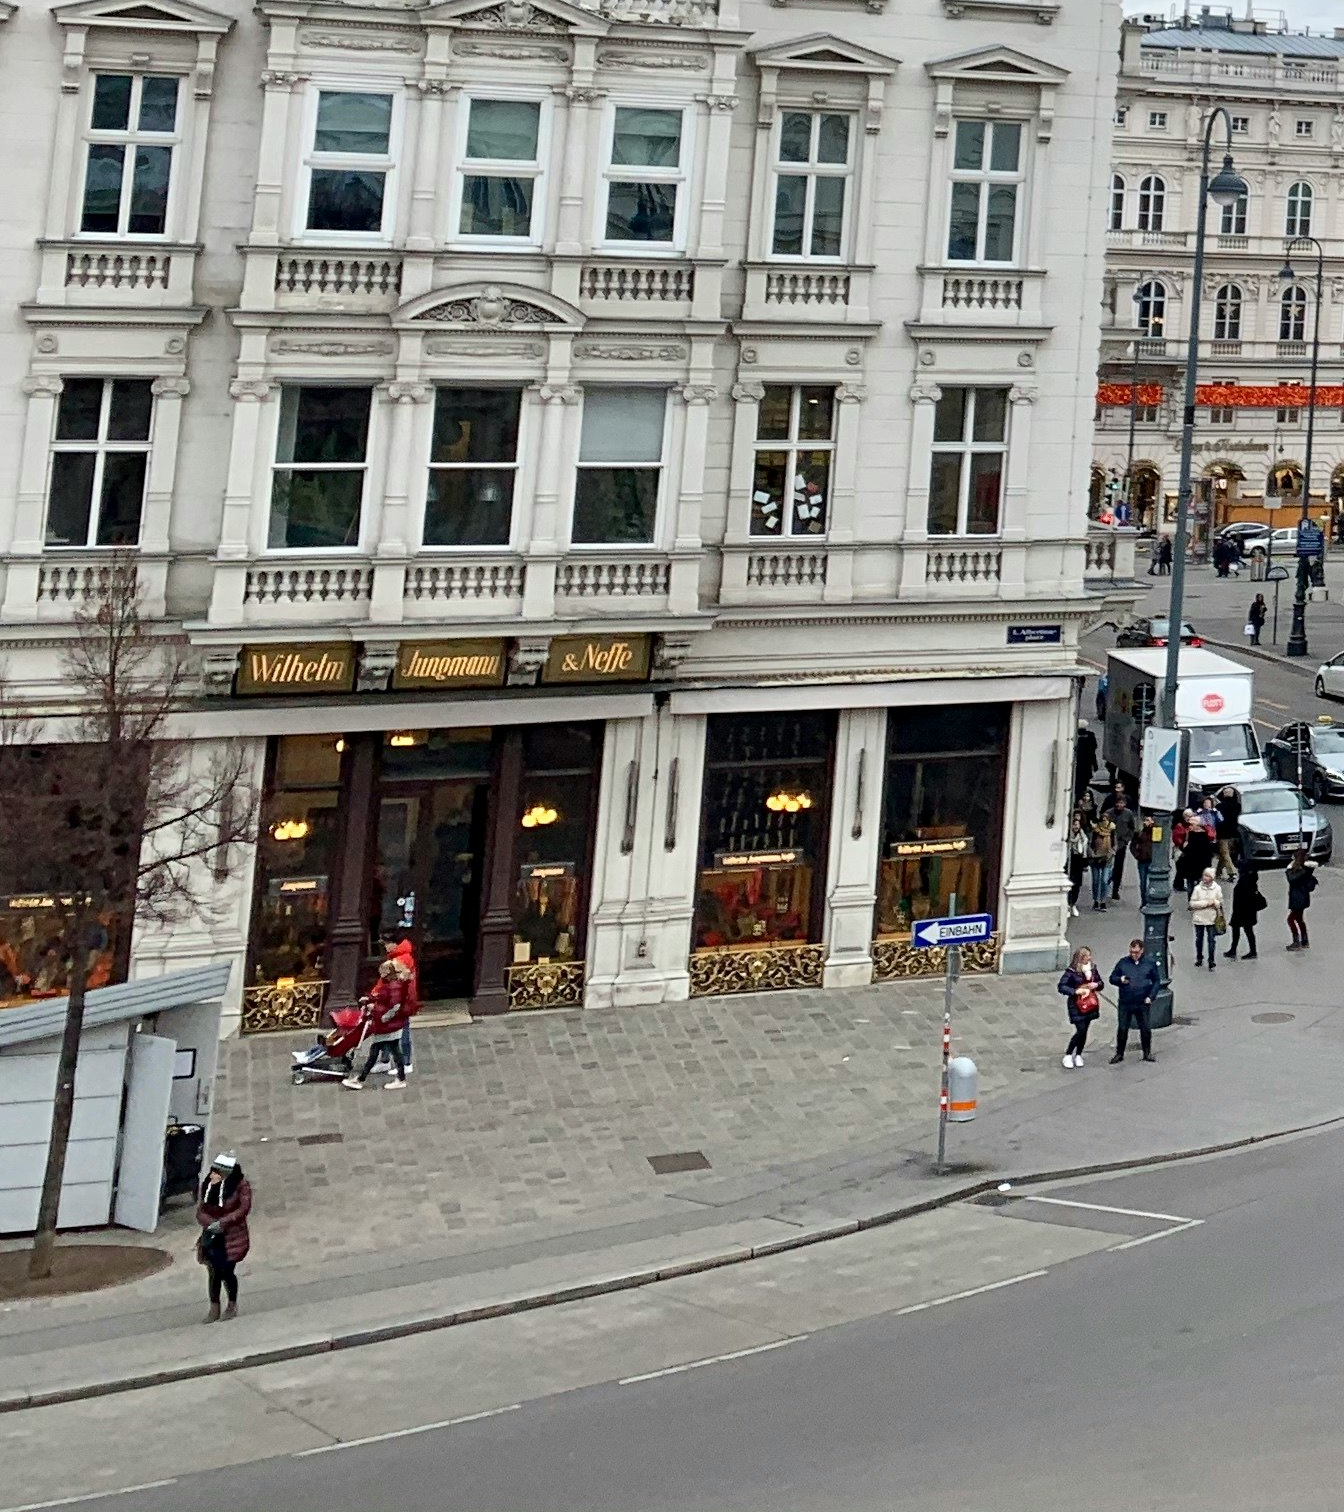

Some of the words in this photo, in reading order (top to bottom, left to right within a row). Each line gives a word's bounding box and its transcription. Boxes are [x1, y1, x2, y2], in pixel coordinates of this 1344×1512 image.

[250, 653, 346, 683] Wilhelm
[401, 648, 499, 681] Jungmann
[561, 655, 578, 671] &
[578, 642, 633, 674] Neffe
[939, 924, 983, 938] EINBAHN
